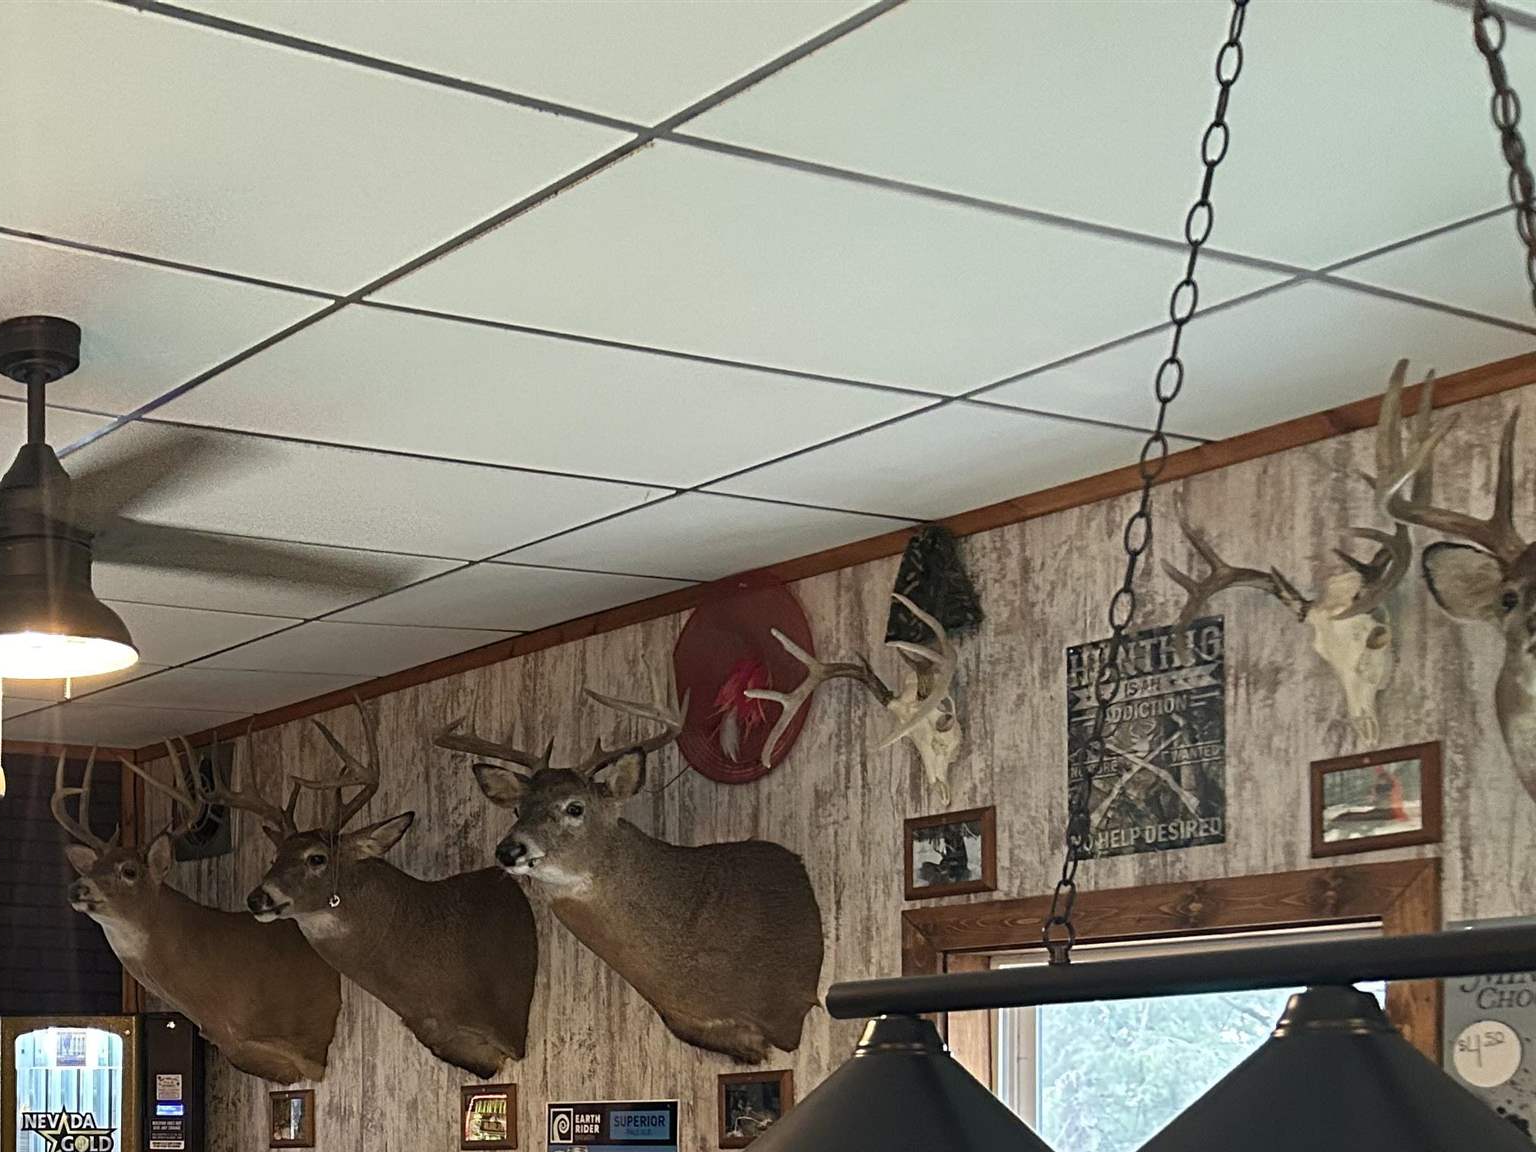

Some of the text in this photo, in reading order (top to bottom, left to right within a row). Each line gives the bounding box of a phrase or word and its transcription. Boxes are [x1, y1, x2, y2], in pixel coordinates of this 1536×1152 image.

[1125, 682, 1138, 697] IS
[1105, 694, 1188, 724] ADDICTION
[1097, 826, 1141, 849] HELP
[1144, 816, 1222, 844] DESIRED
[1477, 986, 1536, 1010] CHO
[24, 1109, 96, 1130] NEVADA
[575, 1113, 601, 1124] EARTH
[614, 1114, 666, 1128] SUPERIOR
[575, 1124, 600, 1134] RIDER
[60, 1134, 114, 1152] GOLD
